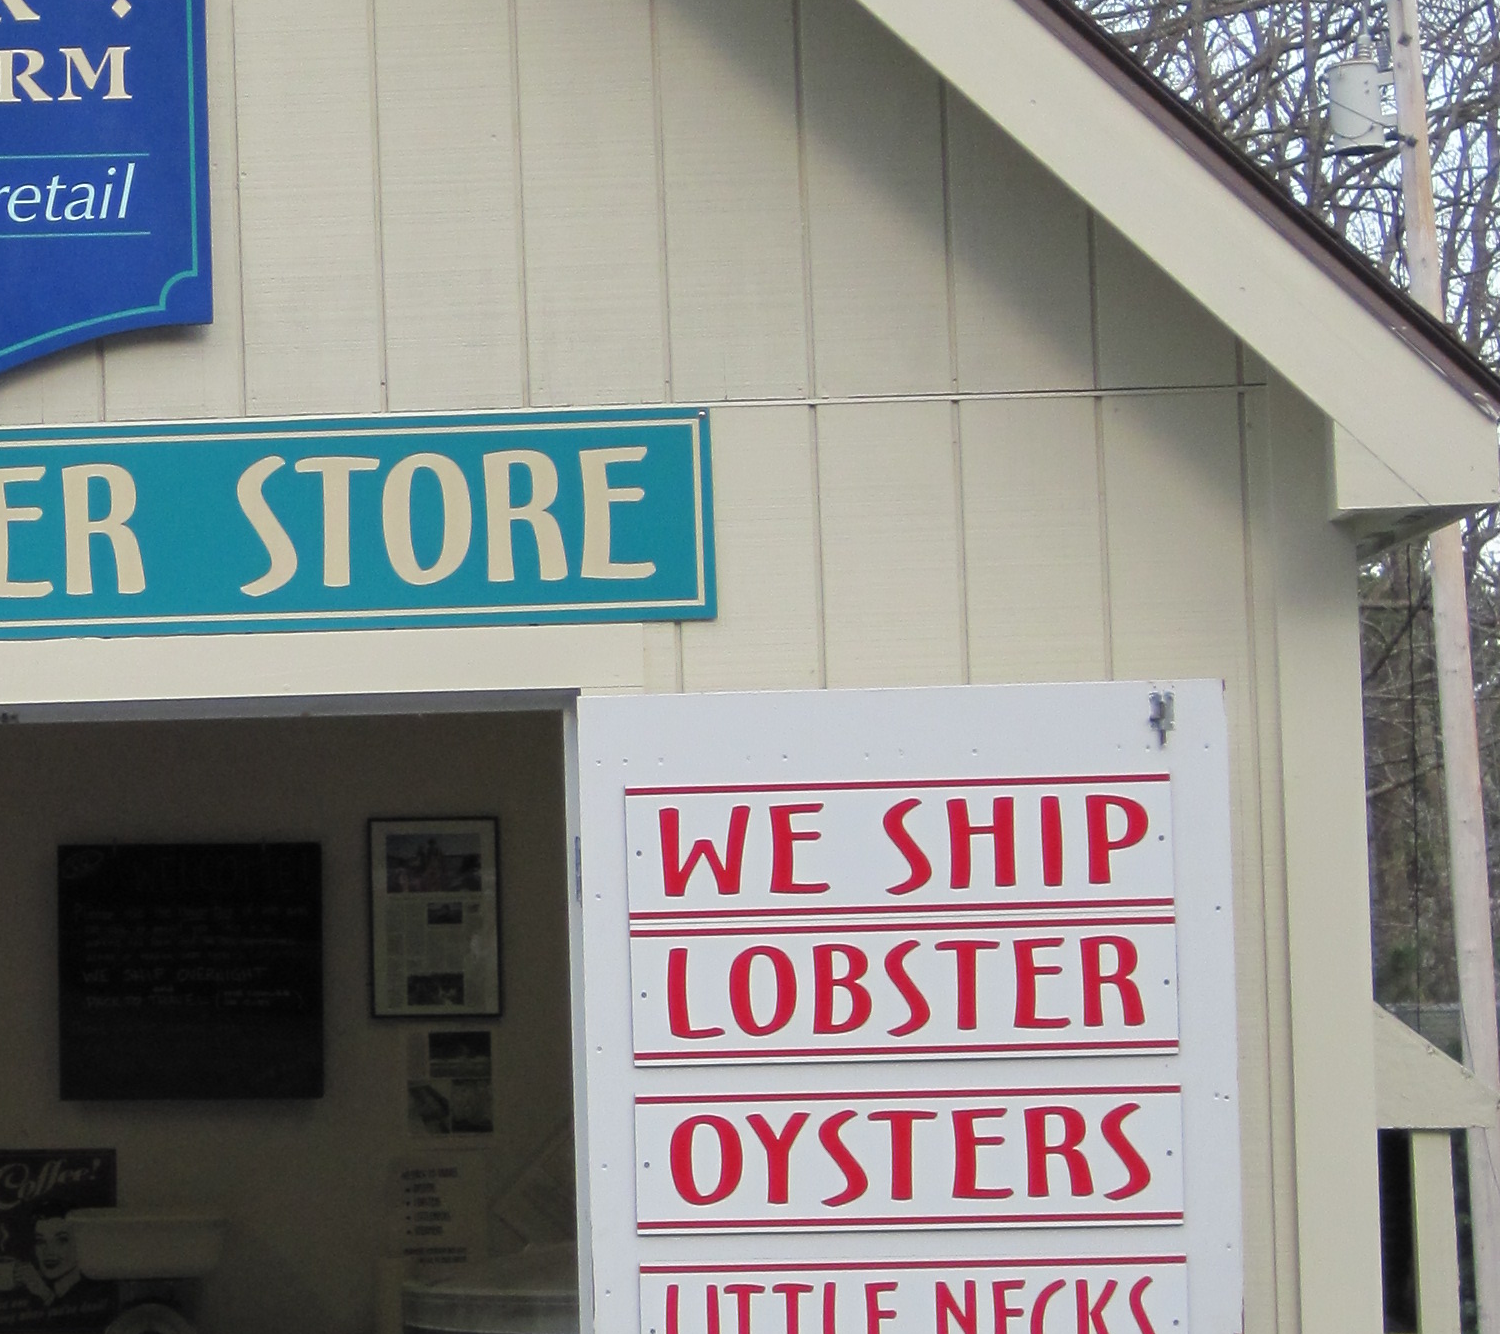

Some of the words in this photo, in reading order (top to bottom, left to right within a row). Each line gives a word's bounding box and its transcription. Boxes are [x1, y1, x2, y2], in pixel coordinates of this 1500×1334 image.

[236, 446, 657, 597] STORE
[659, 802, 830, 898] WE
[881, 795, 1149, 896] SHIP
[666, 935, 1146, 1040] LOBSTER
[669, 1103, 1152, 1207] OYSTERS
